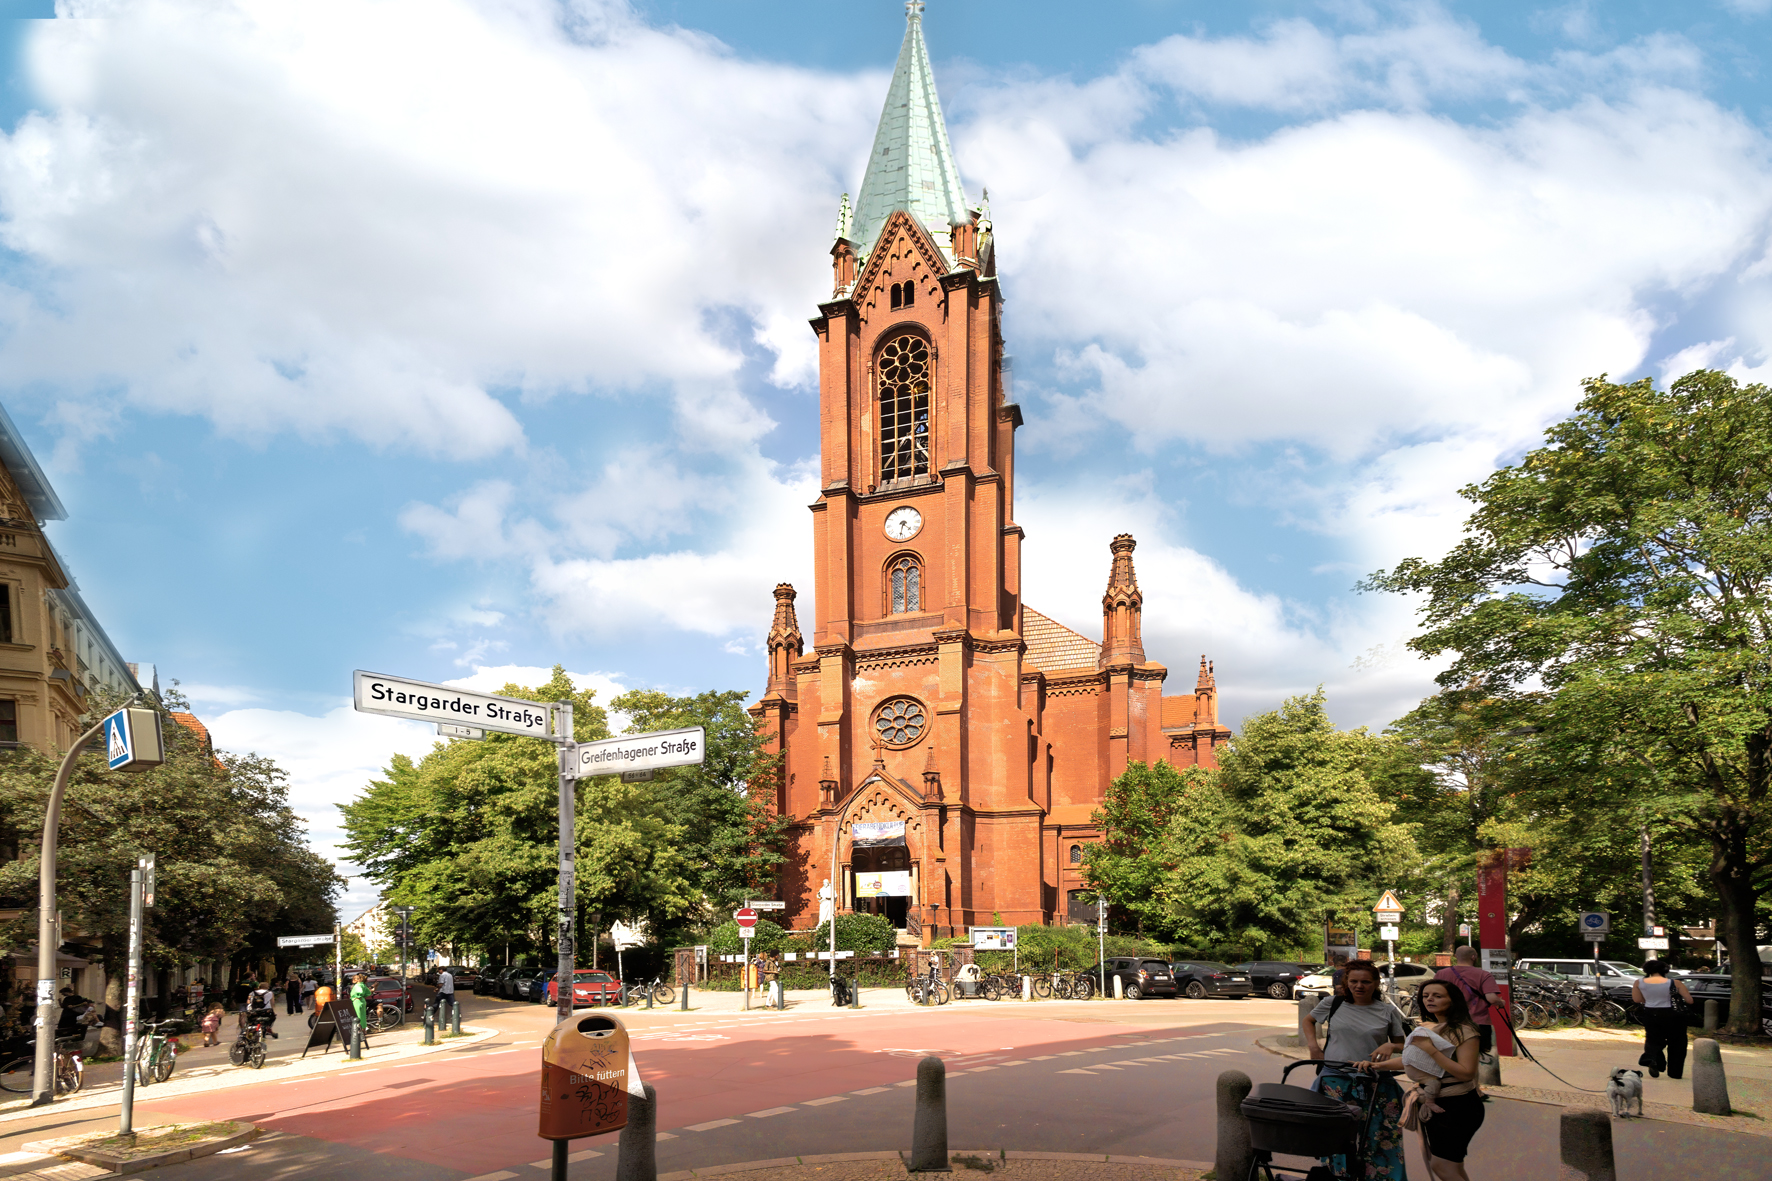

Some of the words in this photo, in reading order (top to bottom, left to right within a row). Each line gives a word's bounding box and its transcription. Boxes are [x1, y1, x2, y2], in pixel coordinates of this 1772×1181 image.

[371, 683, 480, 715] Stargarder
[486, 703, 544, 728] Straße
[581, 746, 658, 764] Greifenhagener
[661, 739, 697, 755] Straße
[569, 1073, 595, 1085] Bitte
[596, 1069, 625, 1081] füttern
